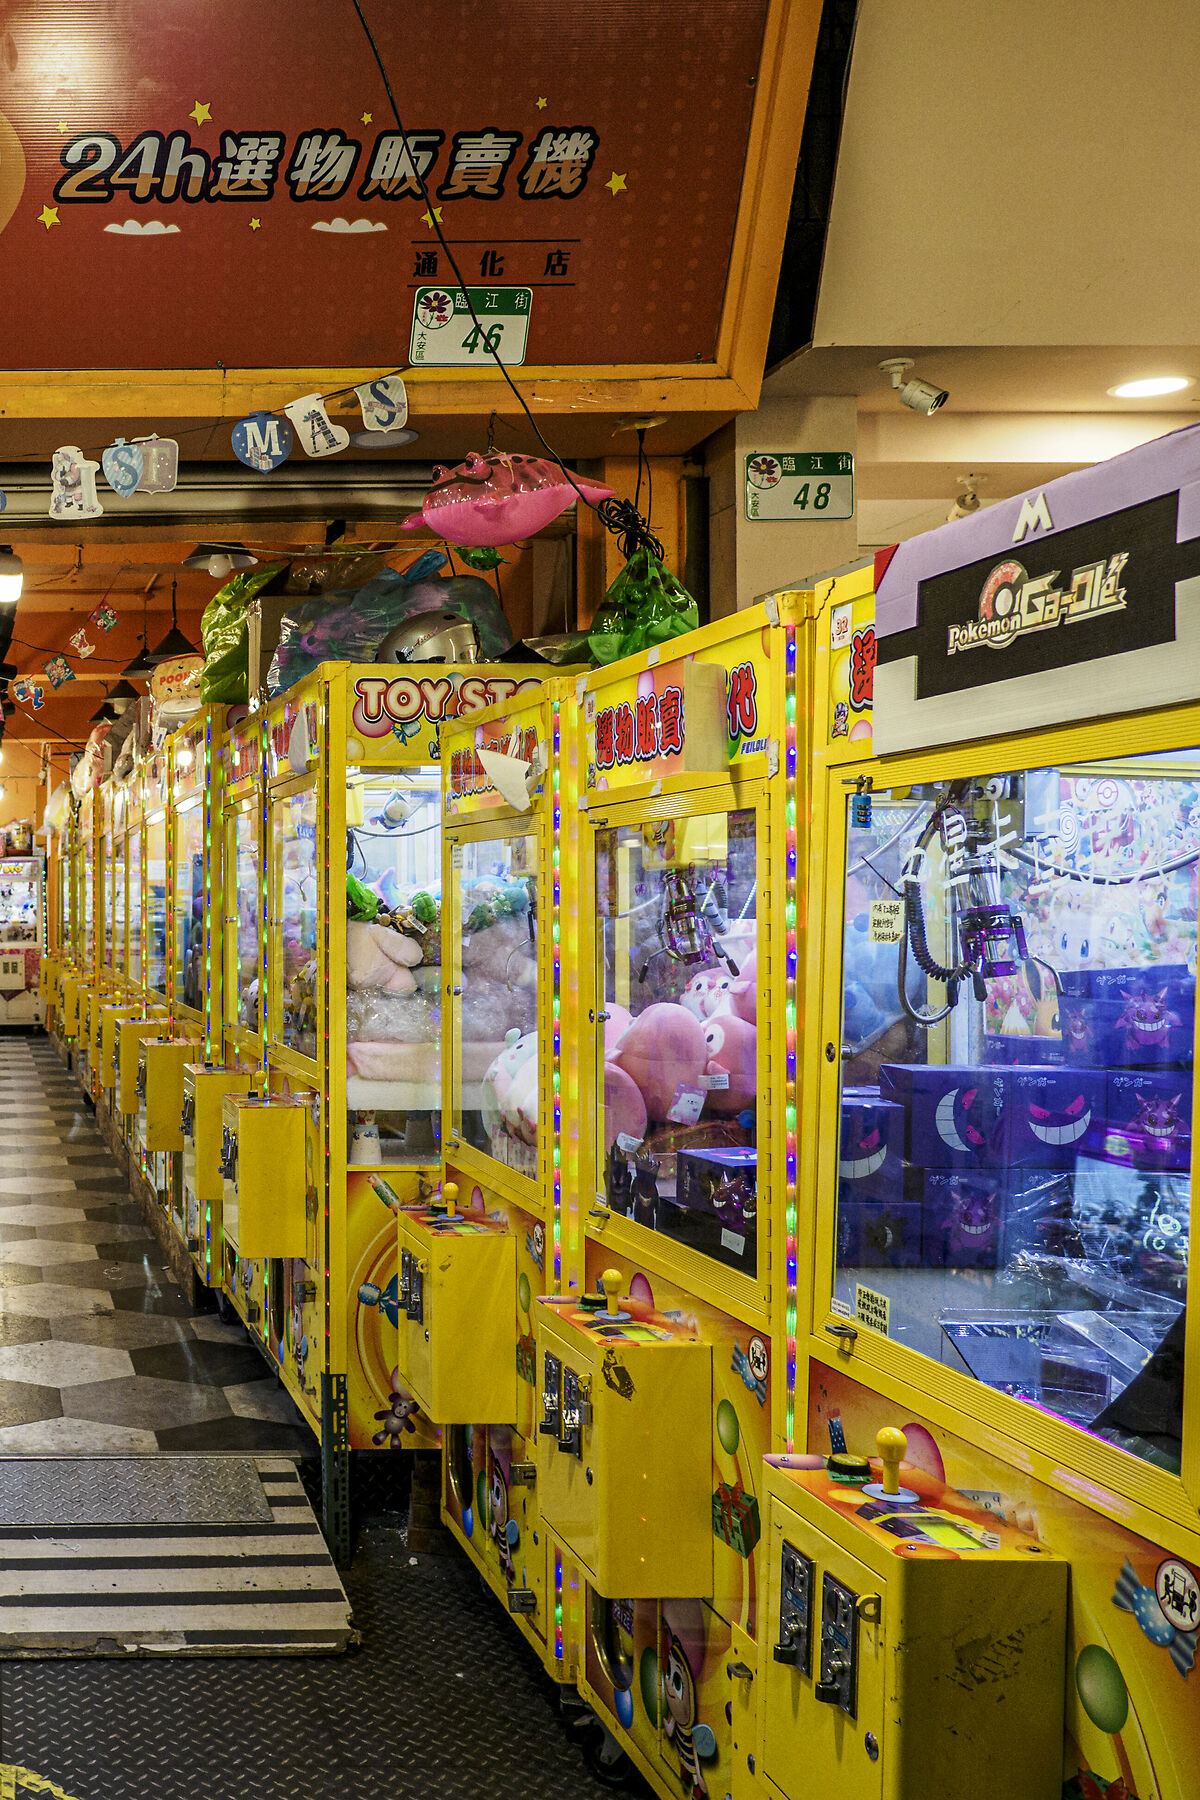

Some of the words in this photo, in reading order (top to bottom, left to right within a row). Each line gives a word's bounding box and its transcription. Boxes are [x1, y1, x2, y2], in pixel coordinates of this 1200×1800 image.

[413, 249, 571, 278] 通化店
[455, 292, 530, 310] 臨江街
[415, 331, 427, 361] 大安區
[461, 323, 505, 355] 46
[782, 455, 852, 471] 臨江街
[793, 482, 832, 510] 48
[948, 611, 1022, 650] Pokémon
[355, 677, 454, 724] TOY
